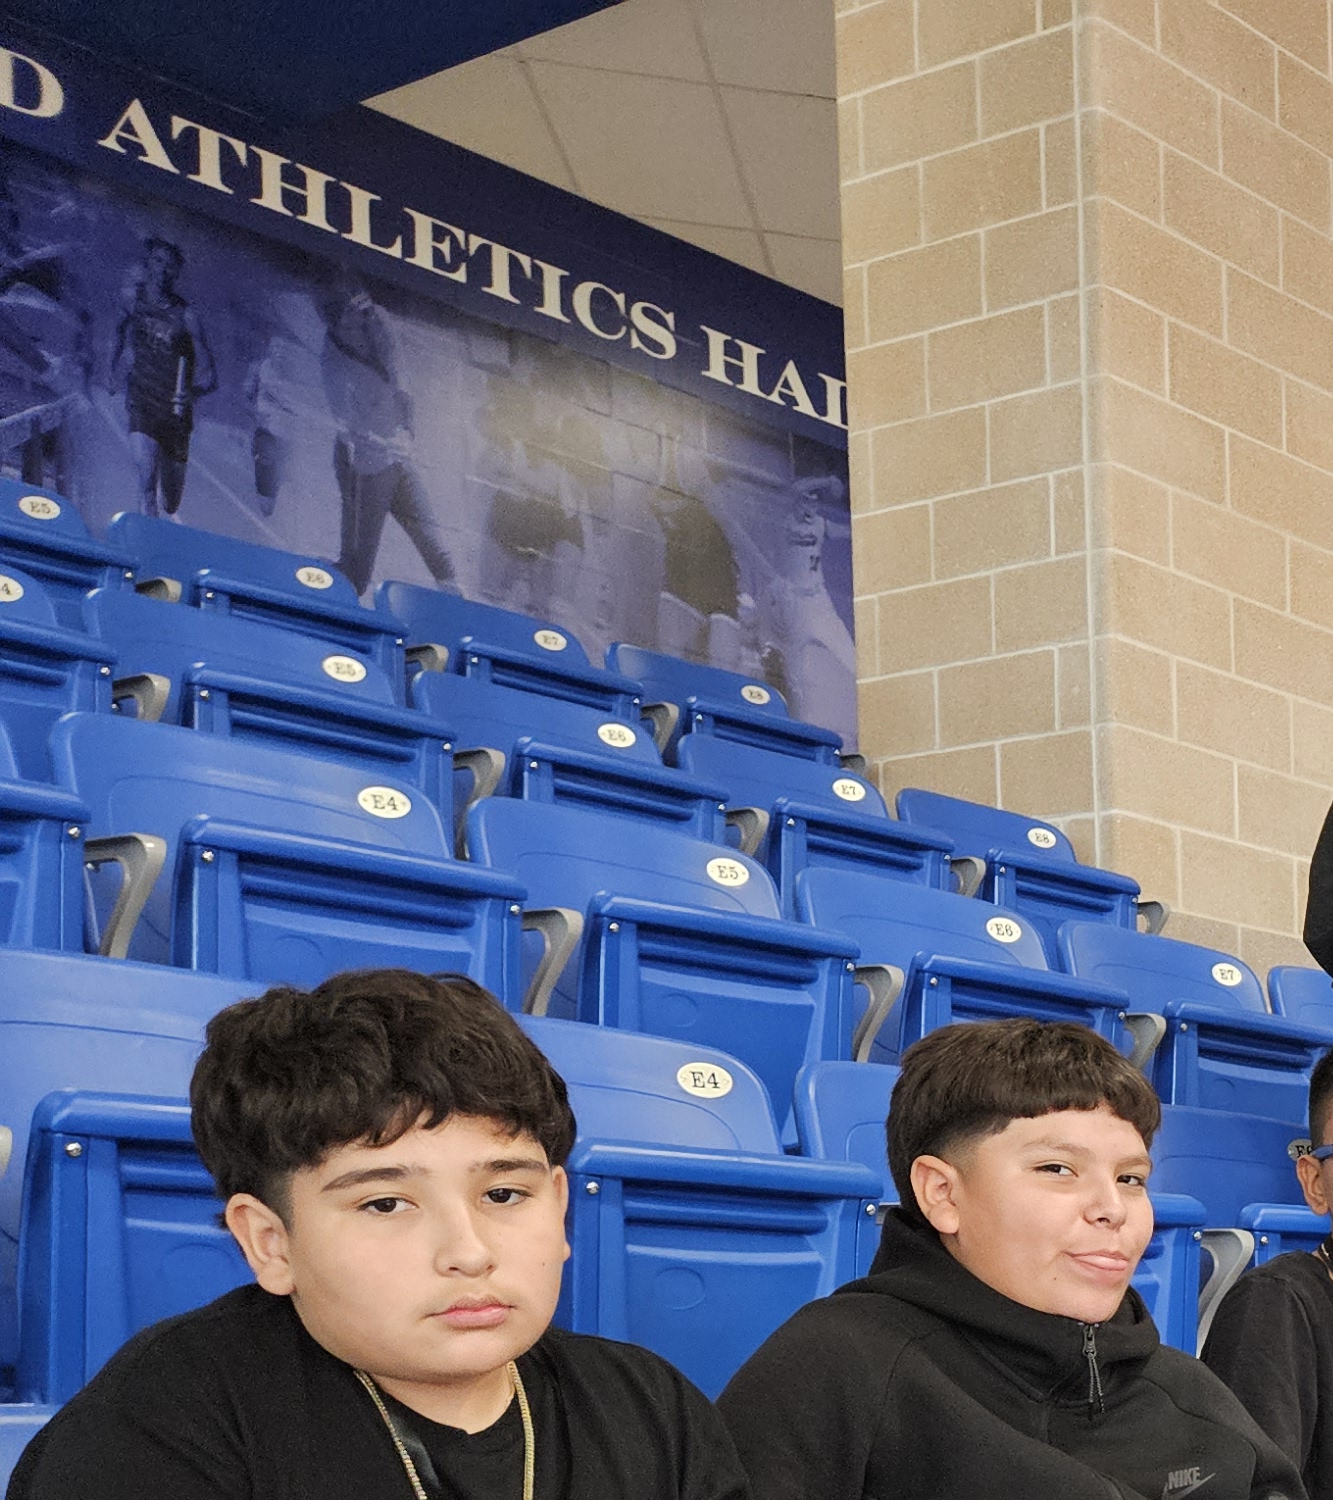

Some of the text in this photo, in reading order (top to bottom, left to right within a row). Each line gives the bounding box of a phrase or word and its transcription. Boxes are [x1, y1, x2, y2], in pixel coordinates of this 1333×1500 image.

[97, 98, 677, 360] ATHLETICS
[333, 662, 356, 677] E5
[841, 784, 856, 795] E7
[371, 794, 399, 811] E4
[1034, 832, 1050, 844] E8
[717, 865, 739, 880] E5
[994, 923, 1014, 937] E6
[1219, 968, 1234, 980] E7
[689, 1071, 721, 1089] E4
[1168, 1466, 1201, 1490] NIKE
